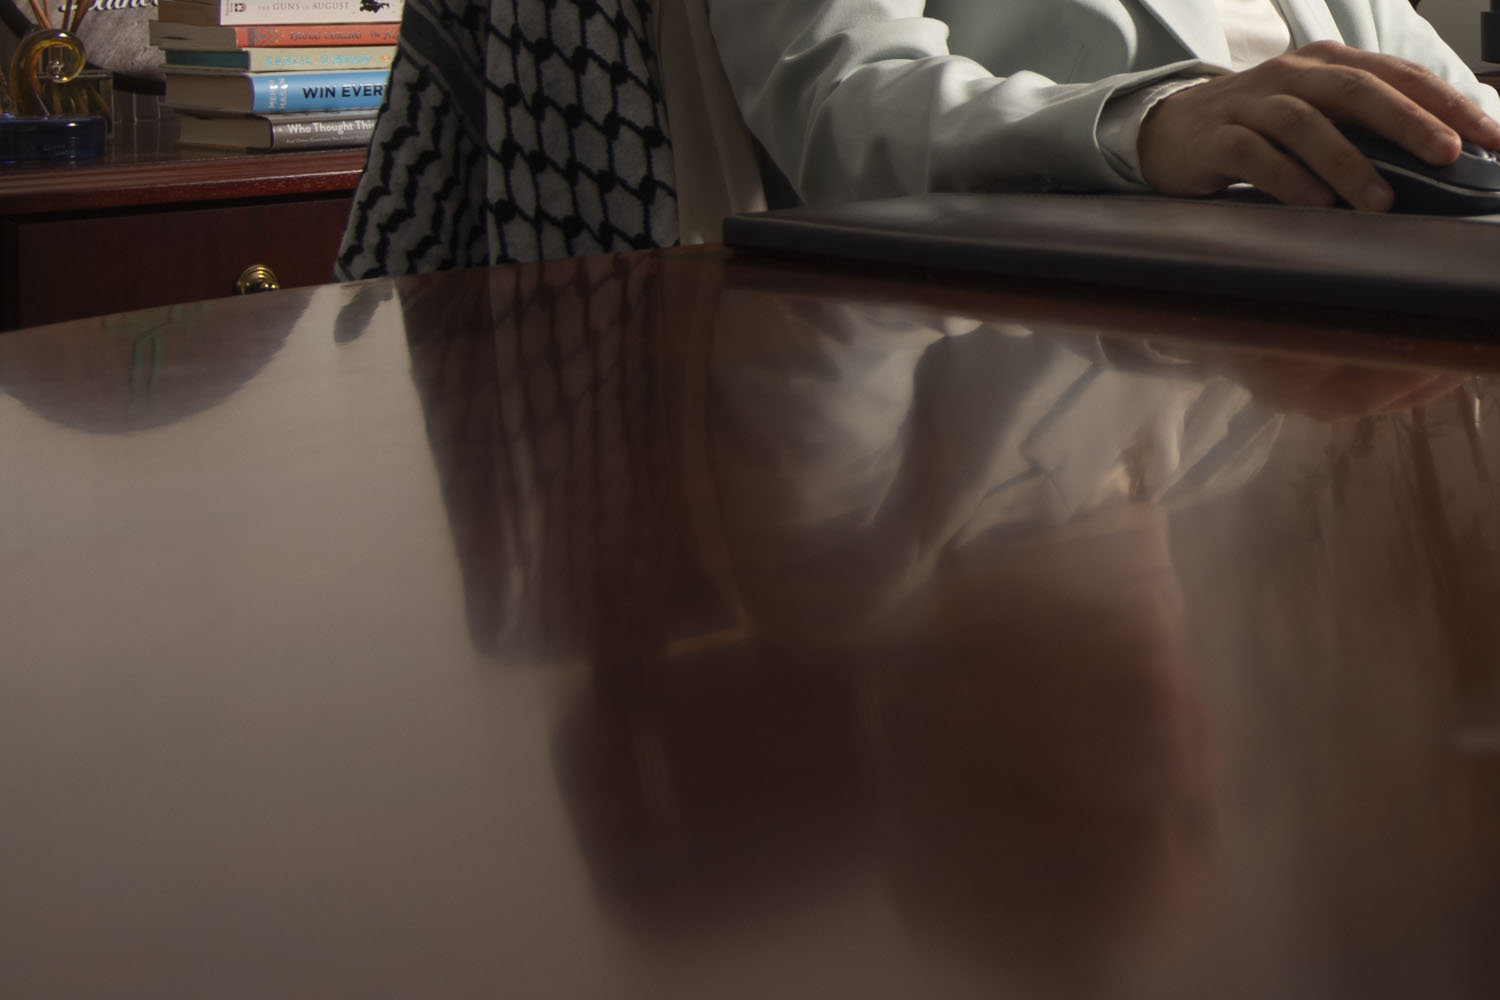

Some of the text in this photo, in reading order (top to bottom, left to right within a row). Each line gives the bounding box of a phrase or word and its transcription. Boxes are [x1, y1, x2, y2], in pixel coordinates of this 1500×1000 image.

[272, 2, 301, 11] GUNS
[312, 1, 350, 10] AUGUST
[319, 54, 371, 65] GIBRAN
[302, 86, 337, 99] WIN
[287, 123, 312, 134] Who
[312, 120, 354, 136] Thought
